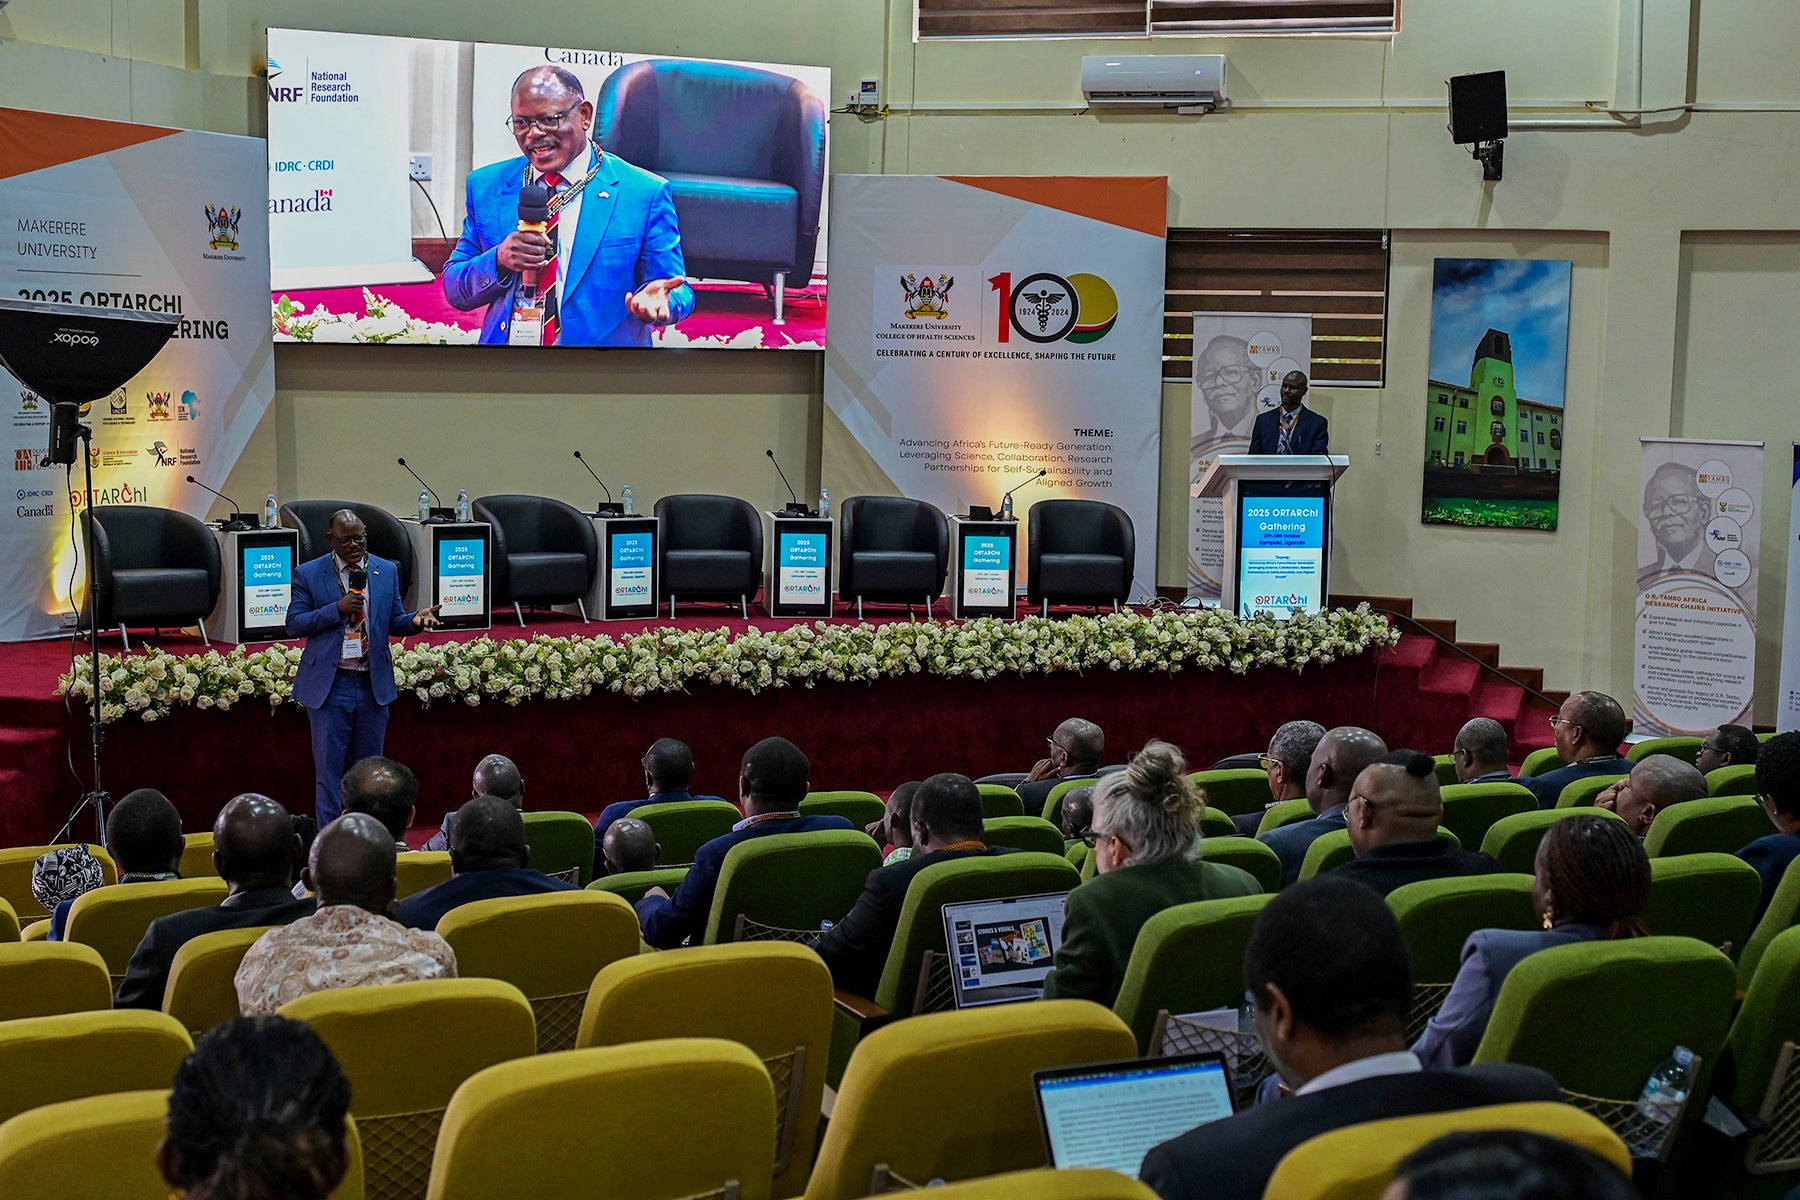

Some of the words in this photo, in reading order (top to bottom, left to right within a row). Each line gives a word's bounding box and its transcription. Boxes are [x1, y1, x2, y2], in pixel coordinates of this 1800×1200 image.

[545, 48, 623, 66] Canada
[312, 72, 346, 80] National
[312, 83, 350, 91] Research
[269, 87, 303, 102] NRF
[311, 93, 358, 102] Foundation
[269, 190, 333, 213] anada
[18, 219, 86, 236] MAKERERE
[18, 243, 97, 259] UNIVERSITY
[876, 349, 926, 357] CELEBRATING
[984, 351, 1032, 360] EXCELLENCE,
[1073, 429, 1113, 437] THEME:
[900, 439, 949, 449] Advancing
[952, 440, 986, 448] Africa's
[989, 441, 1054, 451] Future-Ready
[1057, 442, 1113, 451] Generation:
[161, 458, 177, 466] NRF
[900, 451, 951, 461] Leveraging
[954, 452, 994, 461] Science,
[997, 453, 1065, 462] Collaboration,
[1068, 454, 1112, 463] Research
[924, 463, 984, 473] Partnerships
[1035, 479, 1072, 488] Aligned
[17, 505, 53, 518] Canada
[1260, 522, 1306, 532] Gathering
[1255, 594, 1307, 604] ORTARChI
